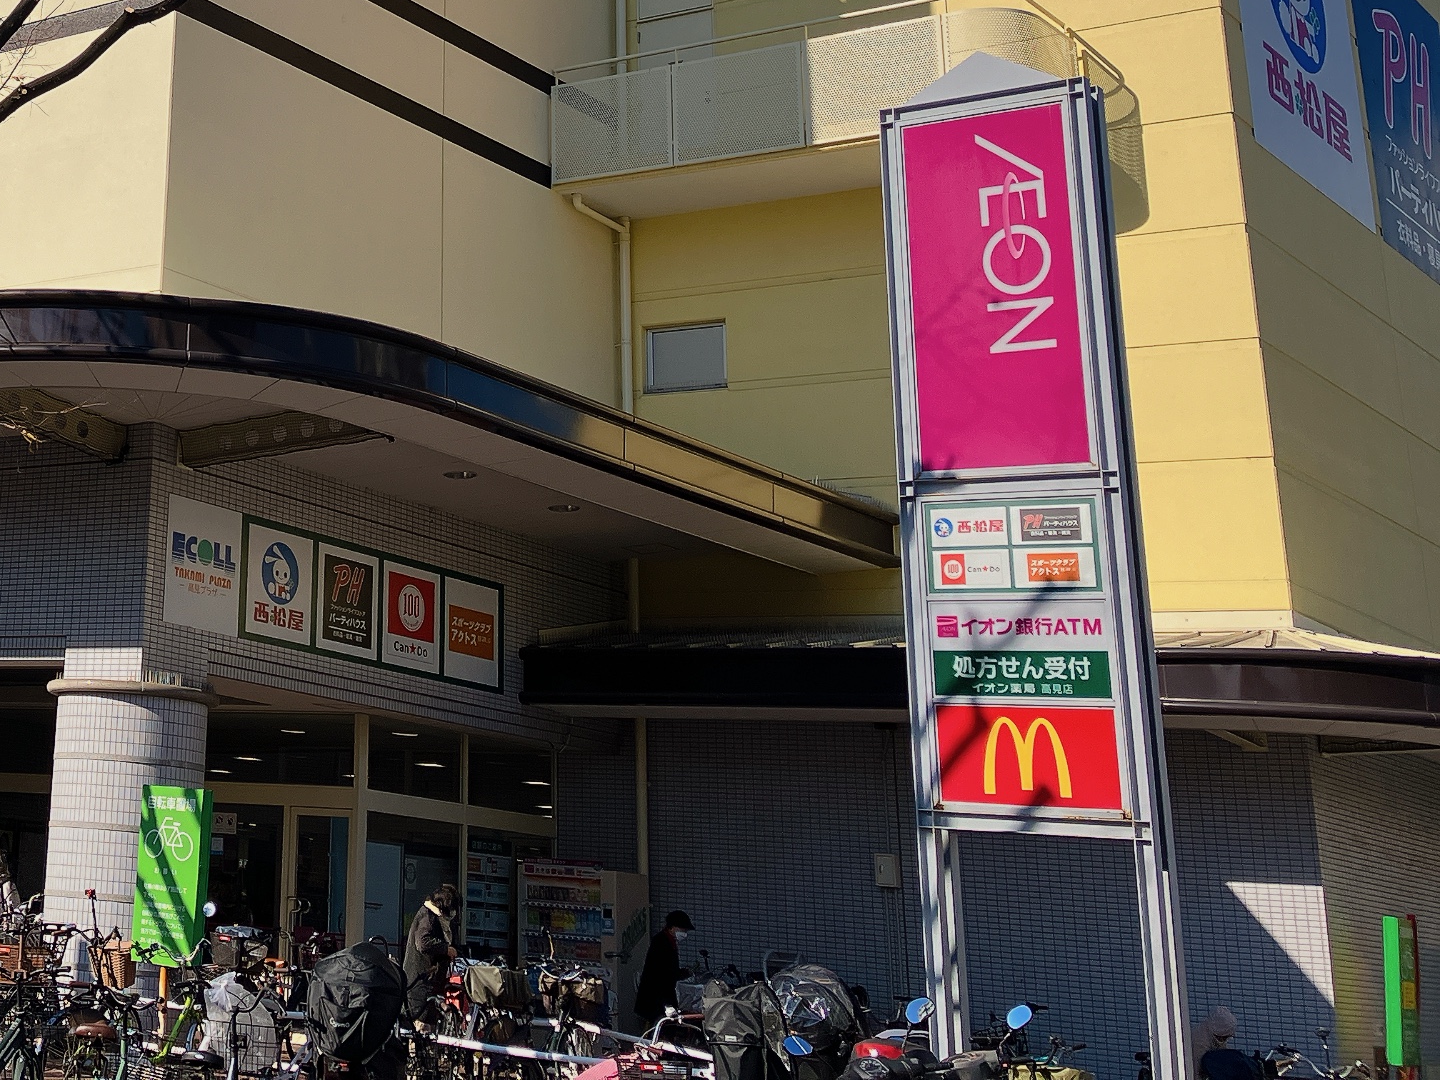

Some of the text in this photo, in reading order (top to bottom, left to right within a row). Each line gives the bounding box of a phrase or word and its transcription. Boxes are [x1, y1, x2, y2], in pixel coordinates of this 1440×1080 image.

[1372, 8, 1432, 160] PH
[1262, 40, 1353, 163] 西松屋
[1390, 166, 1440, 232] パーティハ
[957, 519, 1004, 534] 西松屋
[1023, 514, 1043, 529] PH
[171, 531, 236, 573] ECOLL
[948, 563, 960, 574] 100
[1030, 567, 1060, 577] アクトス
[174, 566, 232, 590] TAKAMI PLAZA
[332, 564, 365, 607] PH
[403, 593, 420, 618] 100
[254, 601, 304, 632] 西松屋
[329, 613, 366, 630] パーティハウス
[451, 616, 492, 633] スポーツクラブ
[962, 618, 1102, 636] イオン銀行ATM
[451, 629, 477, 646] アクトス
[952, 656, 1091, 680] 処方せん受付
[972, 683, 1074, 695] イオン薬局 高見店
[148, 796, 196, 812] 自転車置場
